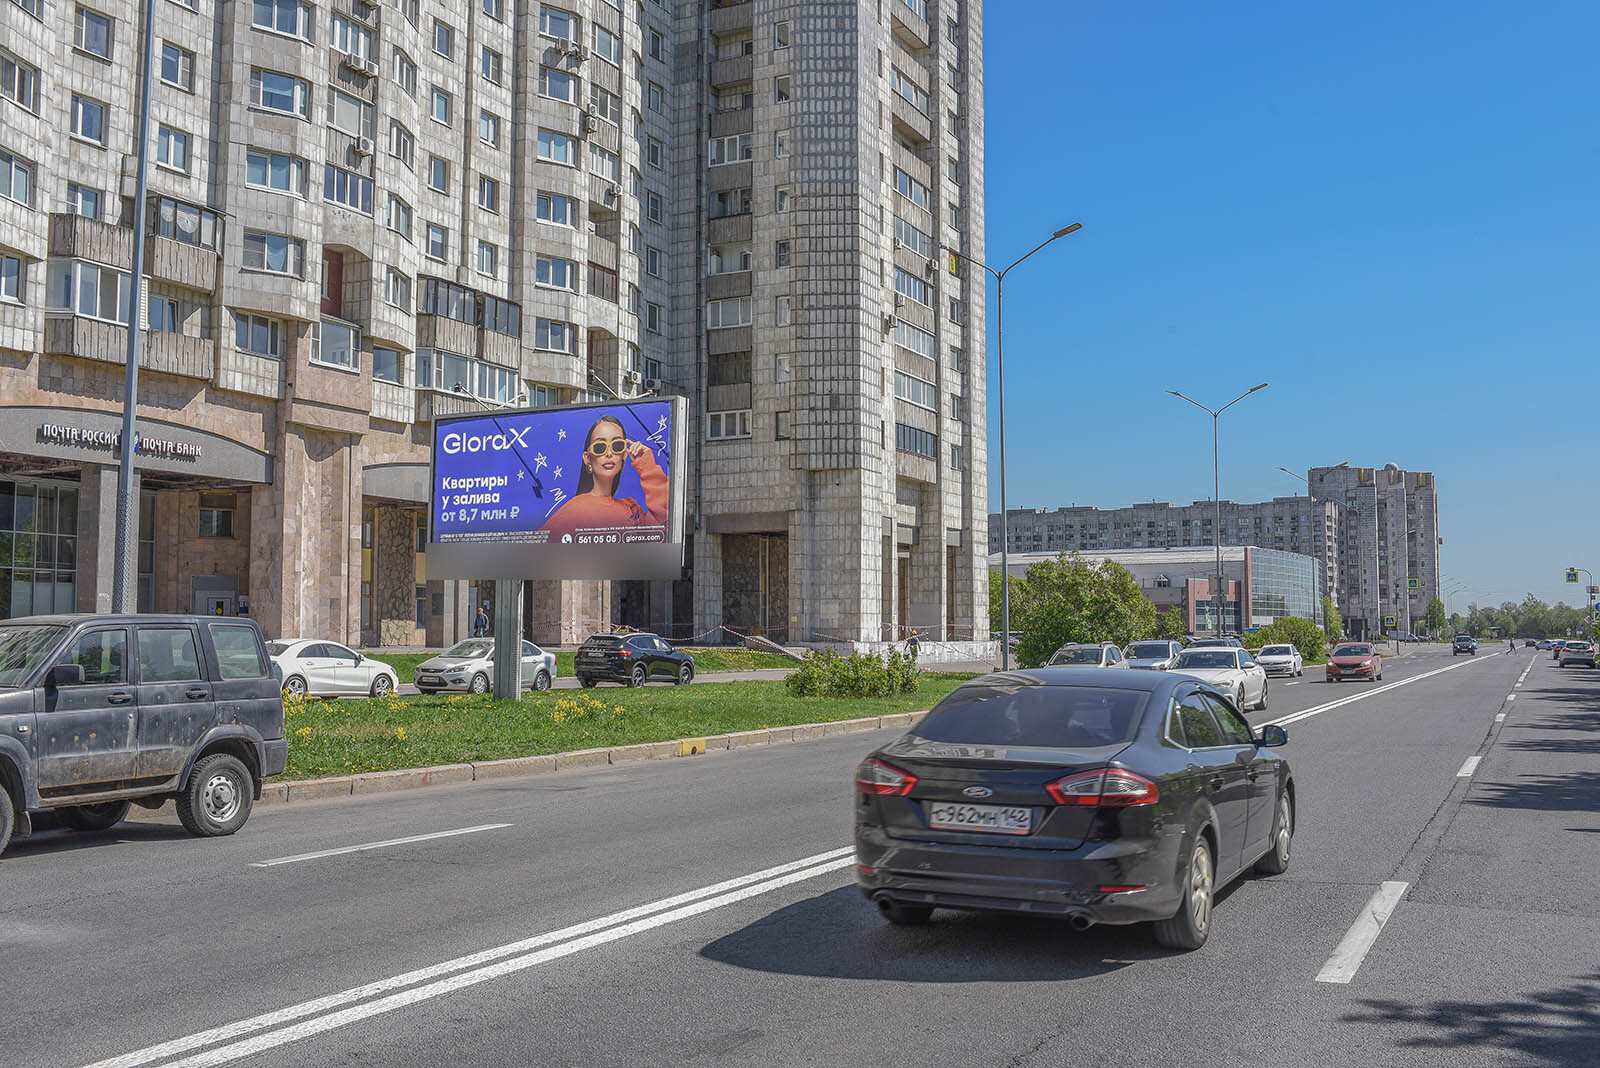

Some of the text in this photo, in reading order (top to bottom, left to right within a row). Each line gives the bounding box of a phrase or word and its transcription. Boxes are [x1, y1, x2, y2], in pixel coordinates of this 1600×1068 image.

[43, 424, 117, 445] ПОЧТА РОССИИ
[443, 426, 532, 454] GloraX
[142, 438, 202, 456] ПОЧТА БАНК
[442, 475, 508, 492] Квартиры
[442, 492, 500, 510] у залива
[441, 511, 456, 522] от
[459, 508, 478, 524] 8,7
[481, 509, 507, 520] млн
[578, 535, 617, 544] 561 05 05
[625, 534, 661, 543] glorax.com
